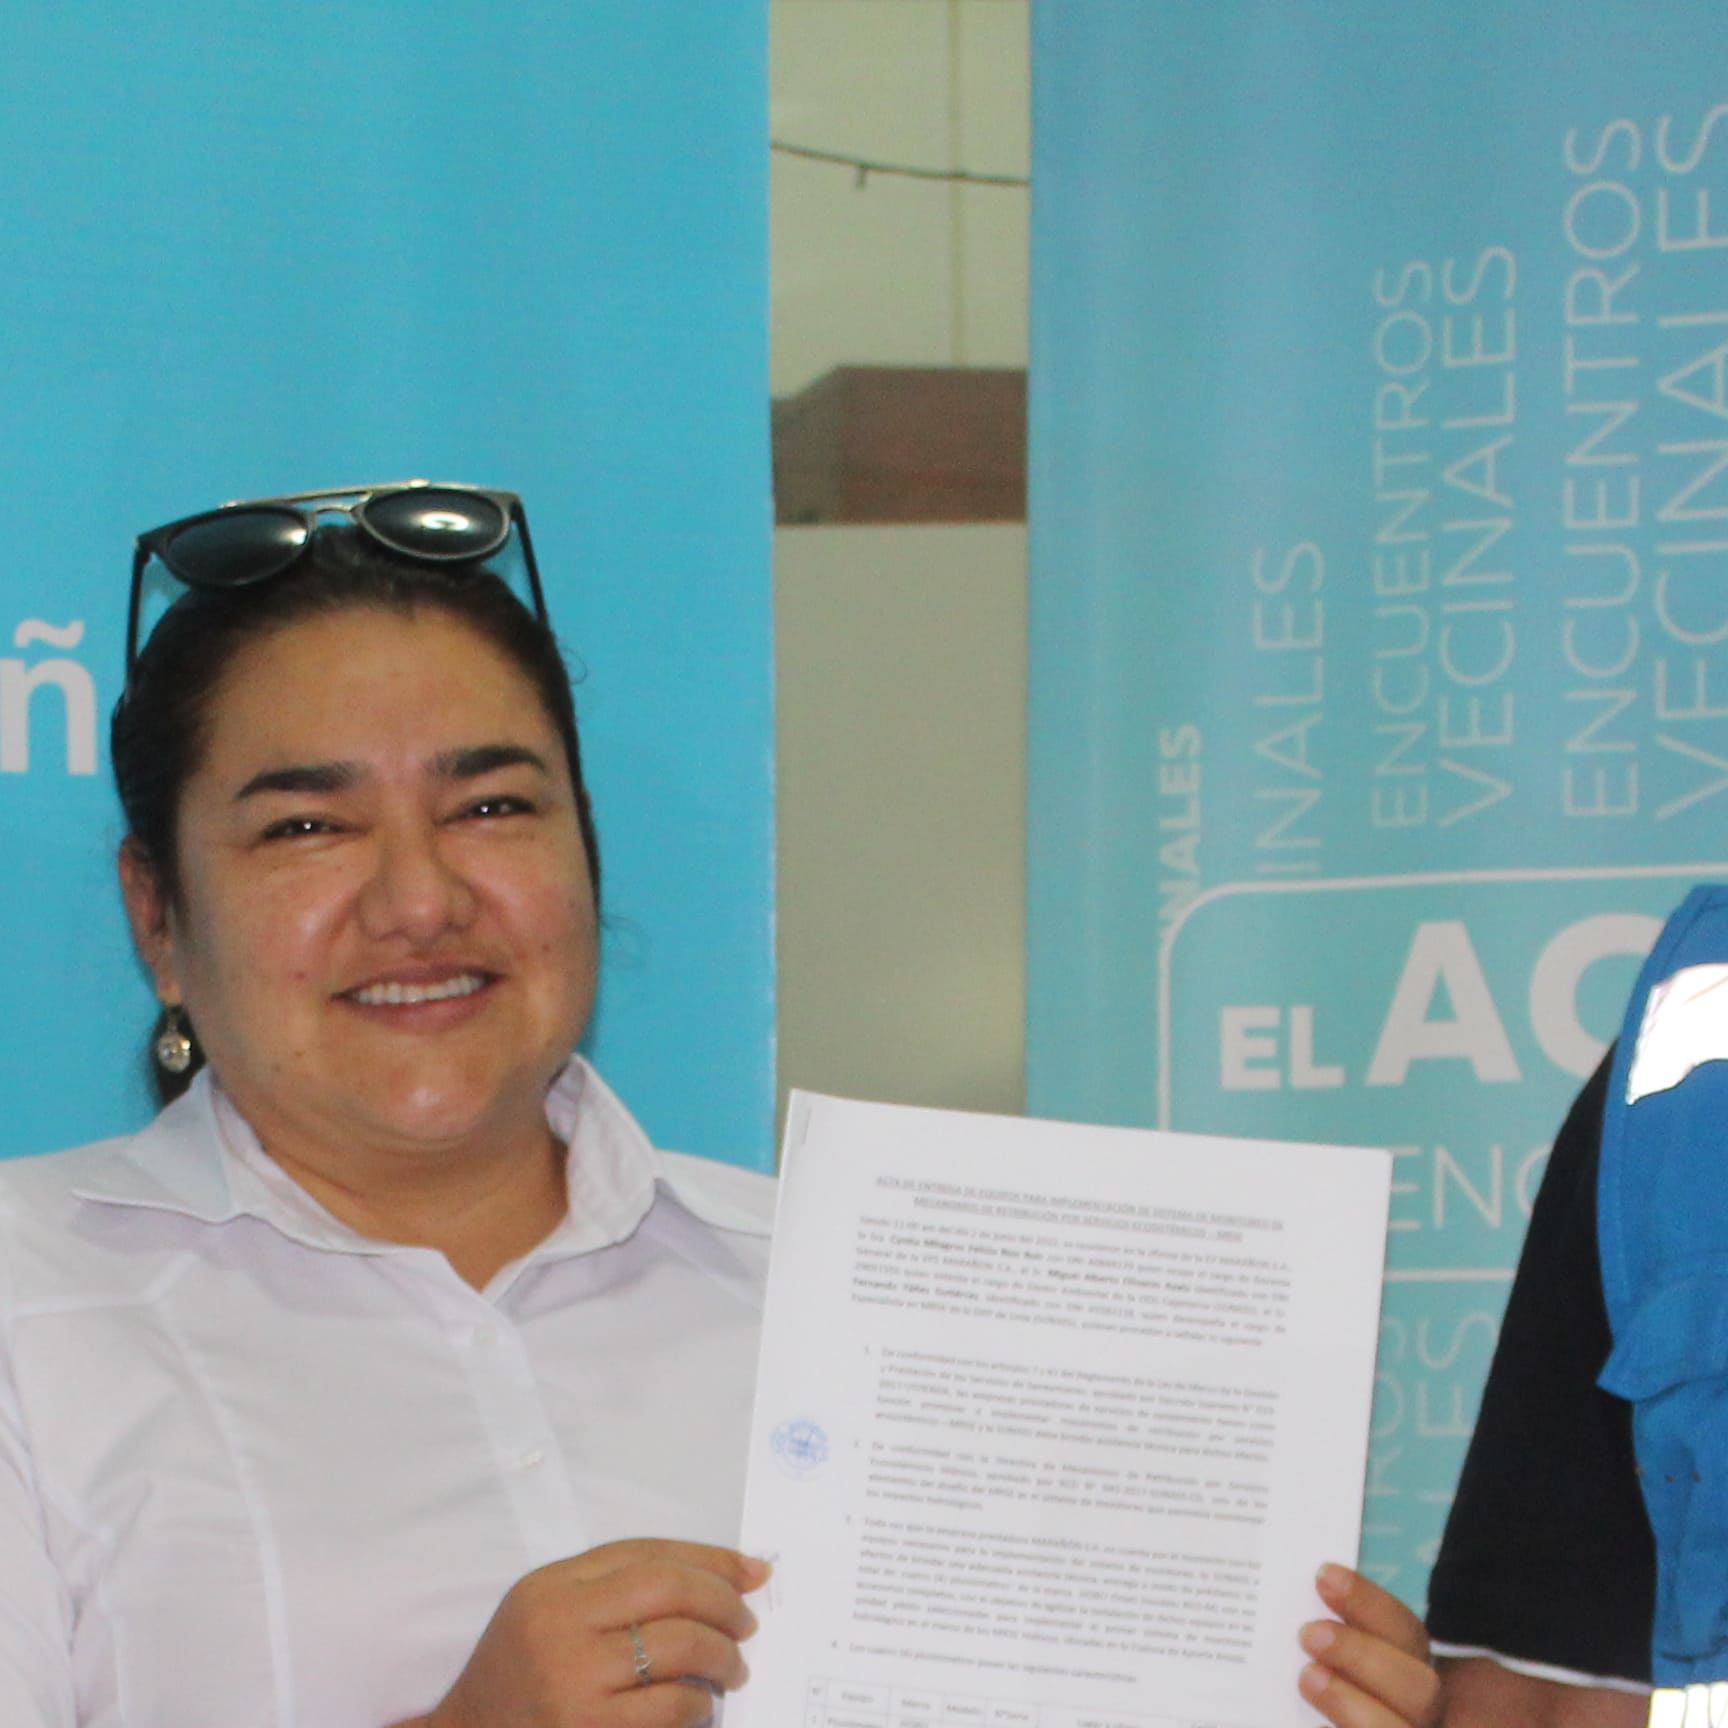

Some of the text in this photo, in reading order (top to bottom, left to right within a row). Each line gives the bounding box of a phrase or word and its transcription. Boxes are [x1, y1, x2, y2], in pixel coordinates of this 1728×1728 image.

[1372, 259, 1432, 829] ENCUENTROS
[1439, 246, 1515, 827] VECINALES
[1563, 117, 1640, 818] ENCUENTROS
[1220, 1006, 1343, 1091] EL
